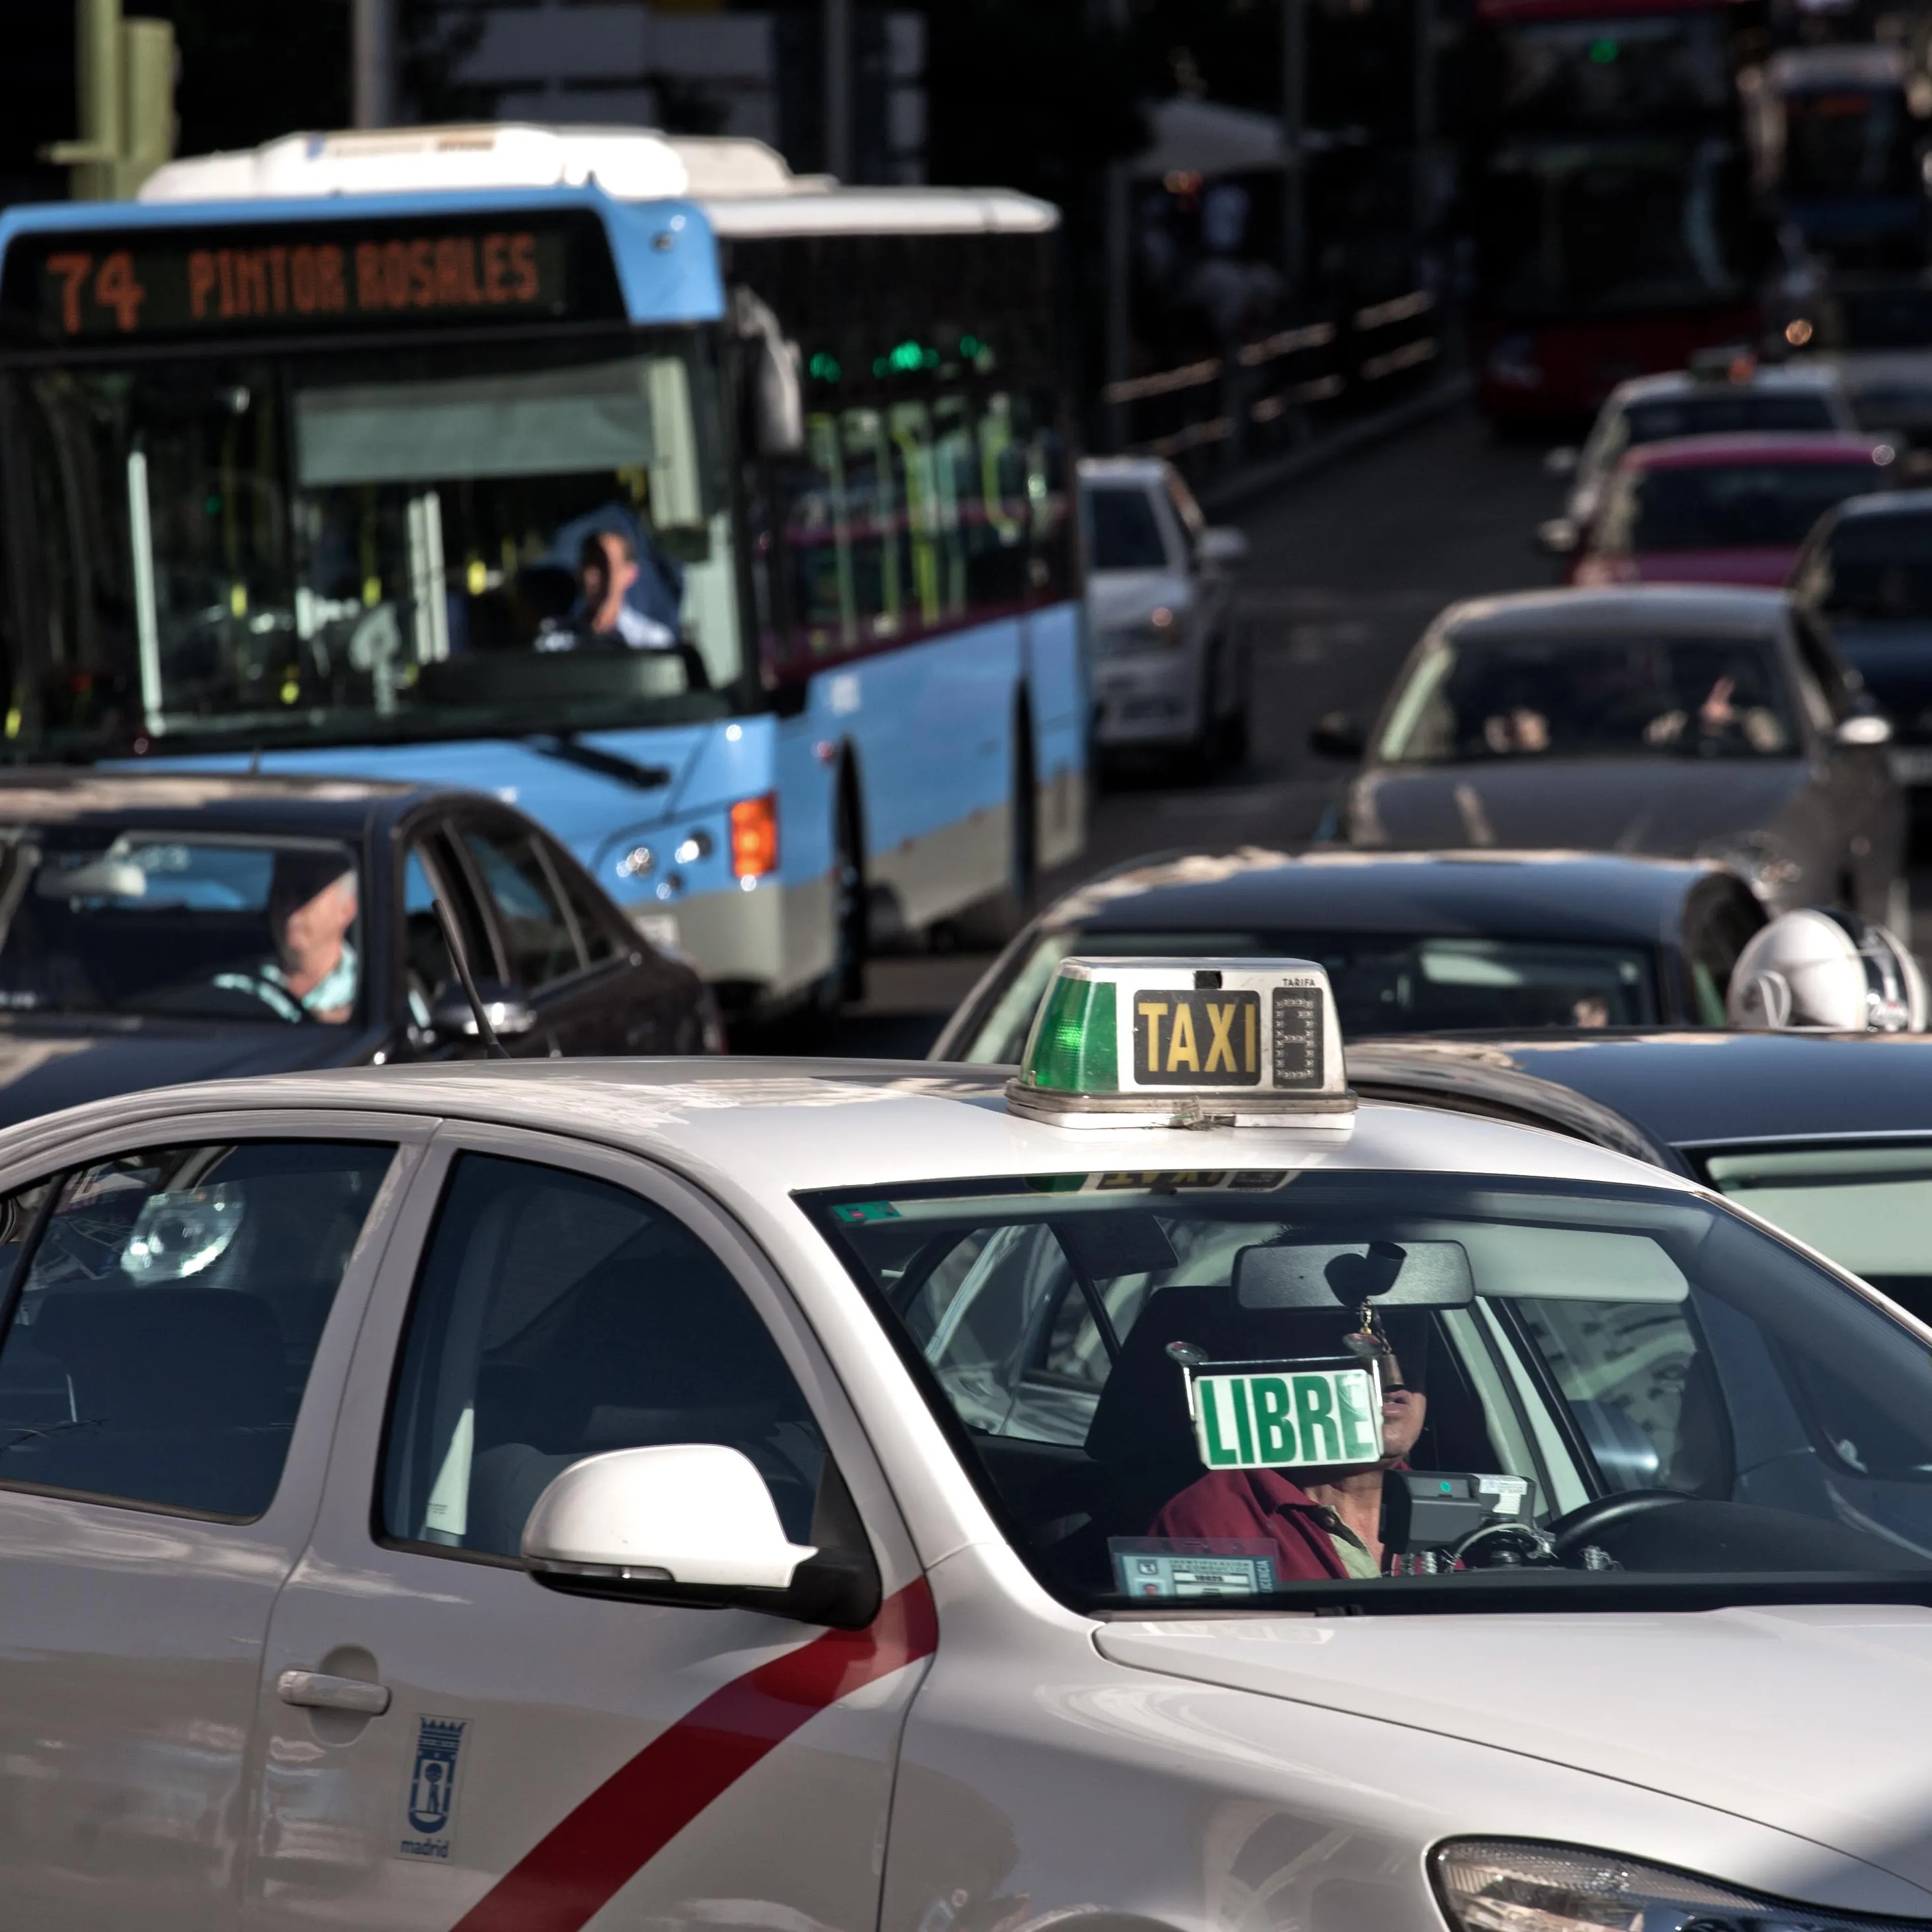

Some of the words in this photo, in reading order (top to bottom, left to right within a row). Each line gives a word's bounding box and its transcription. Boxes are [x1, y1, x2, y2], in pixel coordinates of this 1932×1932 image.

[46, 250, 144, 334] 74
[188, 243, 346, 320] PINTOR
[356, 232, 539, 312] ROSALES
[1282, 978, 1316, 987] TARIFA
[1138, 1002, 1256, 1073] TAXI
[1200, 1373, 1375, 1465] LIBRE
[401, 1838, 450, 1858] madrid
